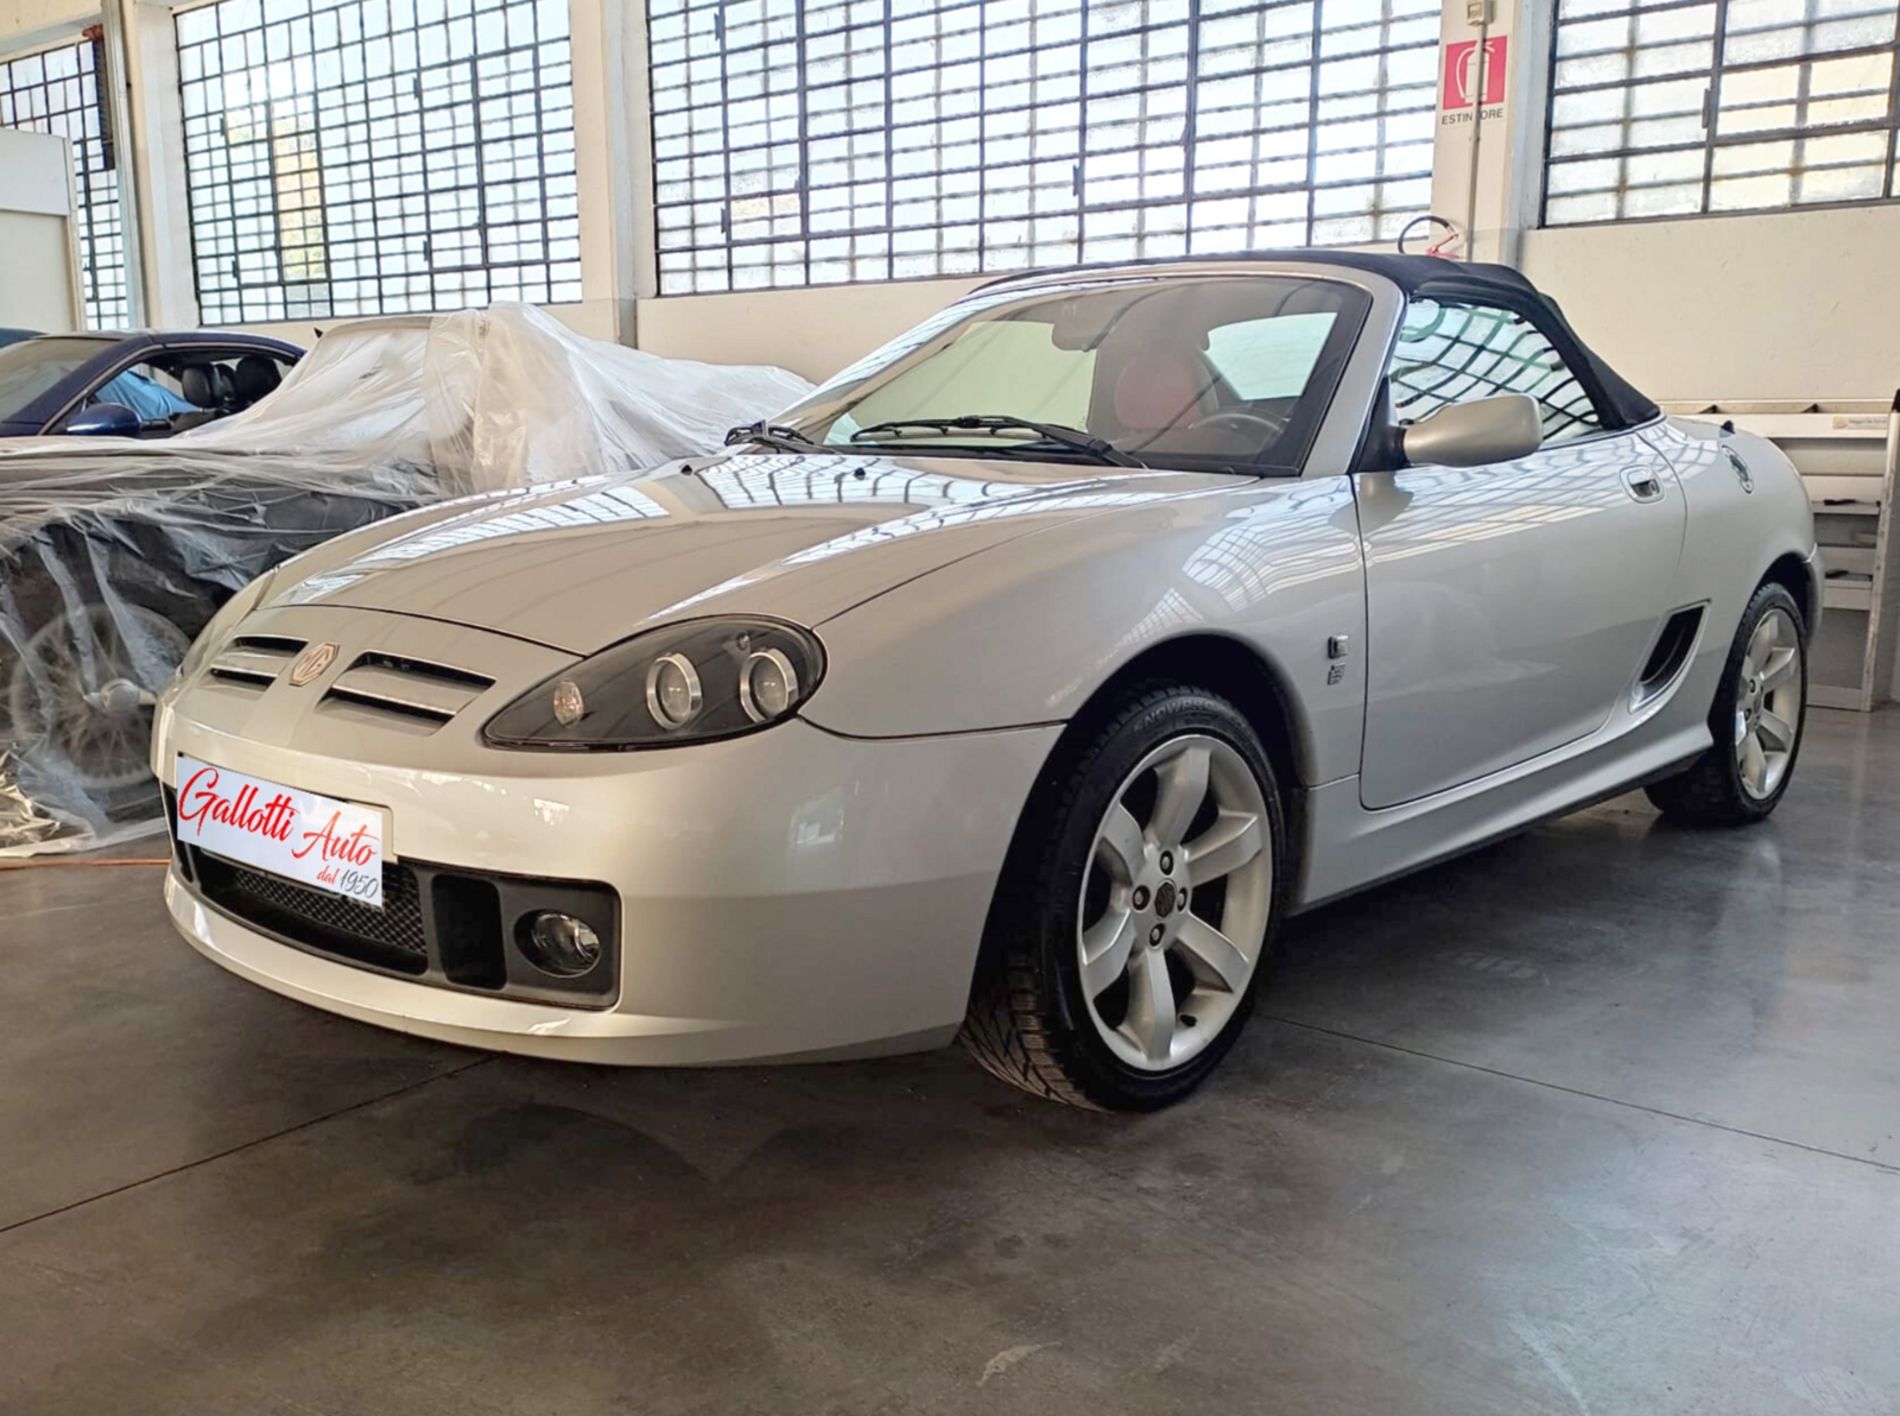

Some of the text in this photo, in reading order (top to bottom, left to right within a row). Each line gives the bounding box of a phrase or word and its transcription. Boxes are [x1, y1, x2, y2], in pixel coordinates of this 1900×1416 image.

[1441, 108, 1504, 125] ESTINORE
[178, 767, 380, 866] Gallotti Auto
[316, 865, 379, 899] dal 1950
